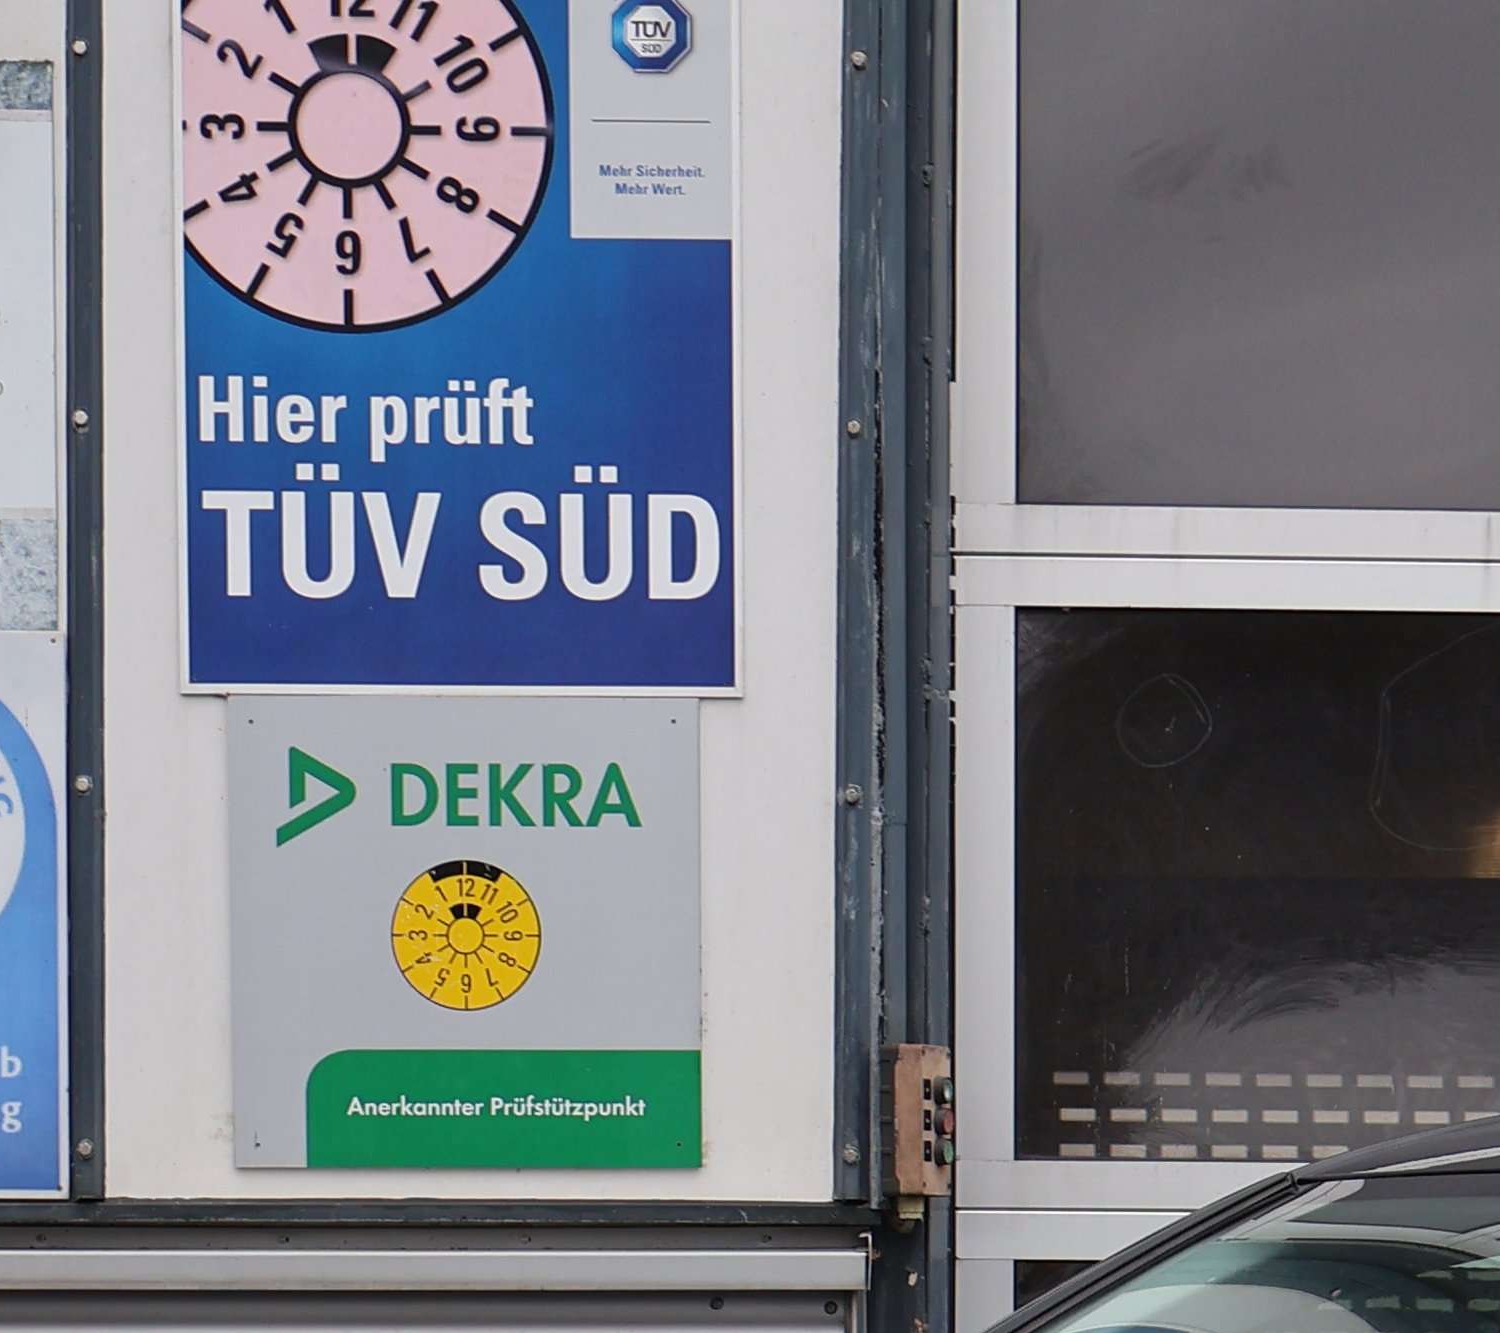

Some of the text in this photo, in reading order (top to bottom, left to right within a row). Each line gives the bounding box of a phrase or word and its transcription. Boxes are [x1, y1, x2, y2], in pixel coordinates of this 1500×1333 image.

[216, 38, 264, 79] 2
[433, 34, 489, 94] 10
[200, 113, 245, 140] 3
[456, 116, 499, 142] 9
[599, 164, 705, 178] Mehr Sicherheit.
[217, 170, 259, 204] 4
[435, 176, 480, 214] 8
[614, 183, 686, 195] Mehr Wert.
[265, 213, 305, 259] 5
[399, 216, 432, 264] 7
[336, 229, 363, 275] 6
[199, 375, 534, 463] Hier prüft
[201, 463, 720, 600] TÜV SÜD
[389, 762, 643, 828] DEKRA
[435, 885, 448, 902] 1
[456, 878, 476, 897] 12
[480, 884, 499, 905] 11
[414, 903, 435, 920] 2
[496, 901, 519, 924] 10
[408, 930, 428, 941] 3
[503, 930, 524, 941] 9
[415, 952, 432, 965] 4
[498, 952, 517, 968] 8
[434, 968, 450, 987] 5
[461, 973, 472, 993] 6
[485, 968, 499, 987] 7
[347, 1094, 646, 1123] Anerkannter Prüfstützpunkt
